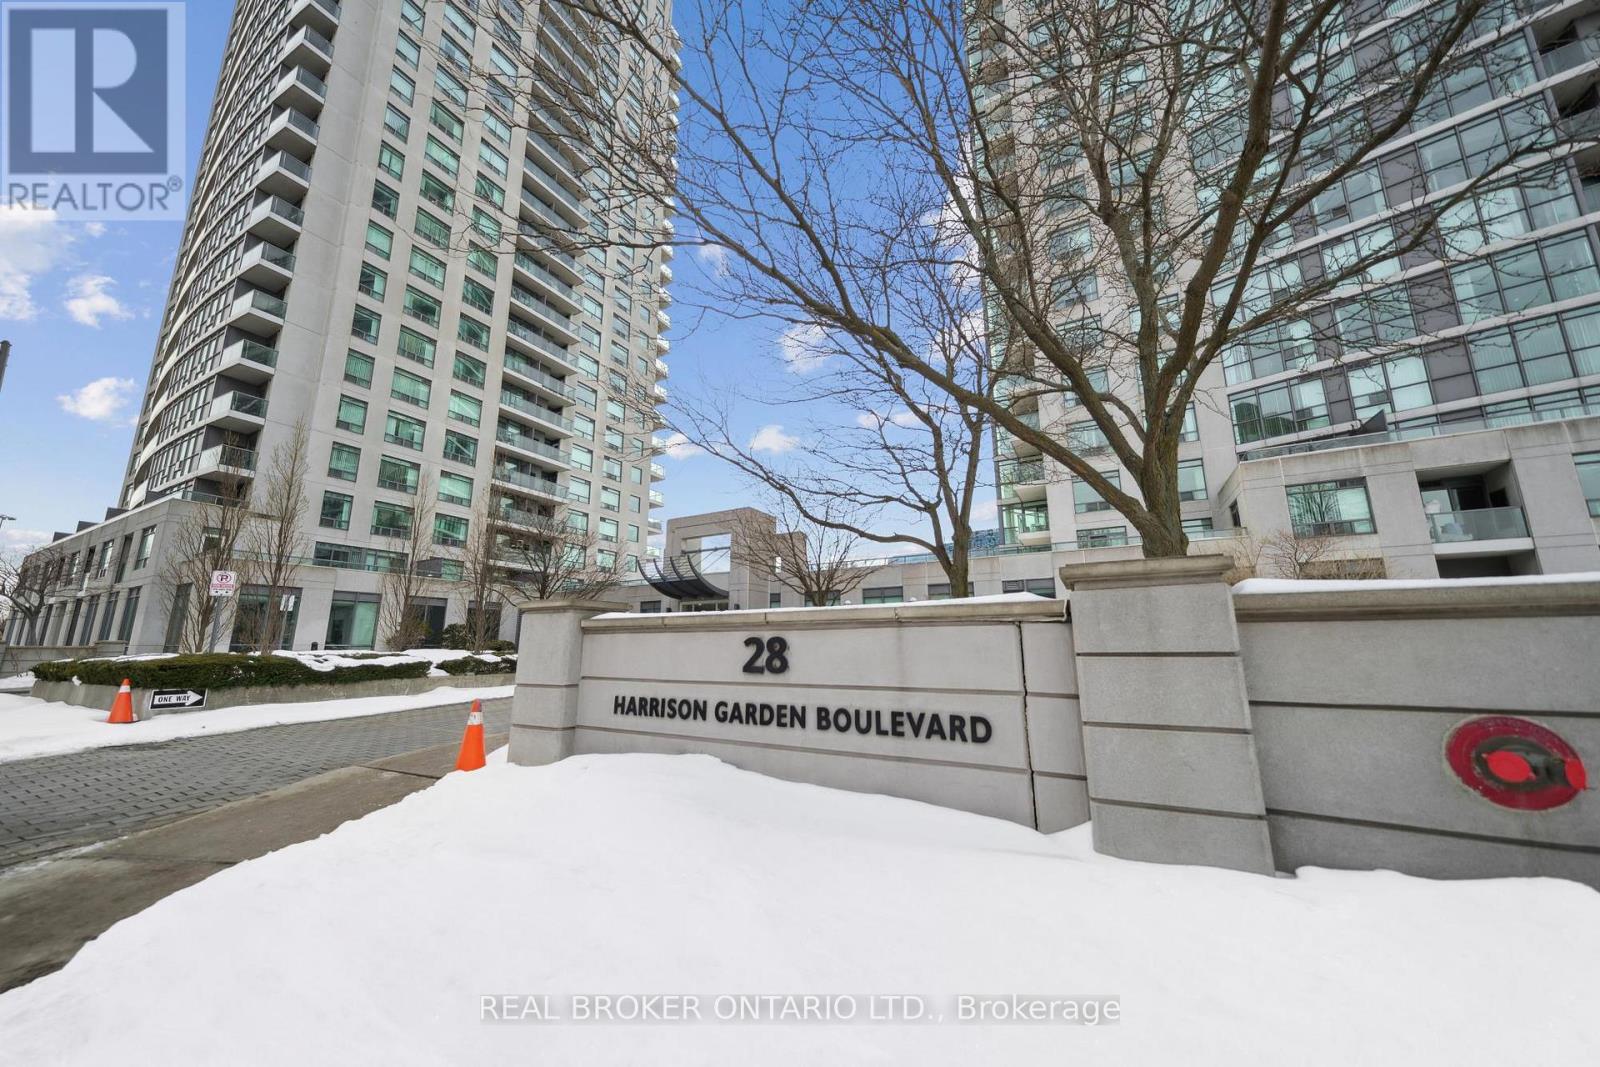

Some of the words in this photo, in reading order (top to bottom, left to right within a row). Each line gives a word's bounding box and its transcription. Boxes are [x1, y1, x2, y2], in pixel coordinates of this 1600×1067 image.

[742, 636, 790, 674] 28
[176, 694, 191, 702] WAY
[613, 695, 707, 721] HARRISON
[714, 700, 806, 729] GARDEN
[816, 707, 993, 744] BOULEVARD
